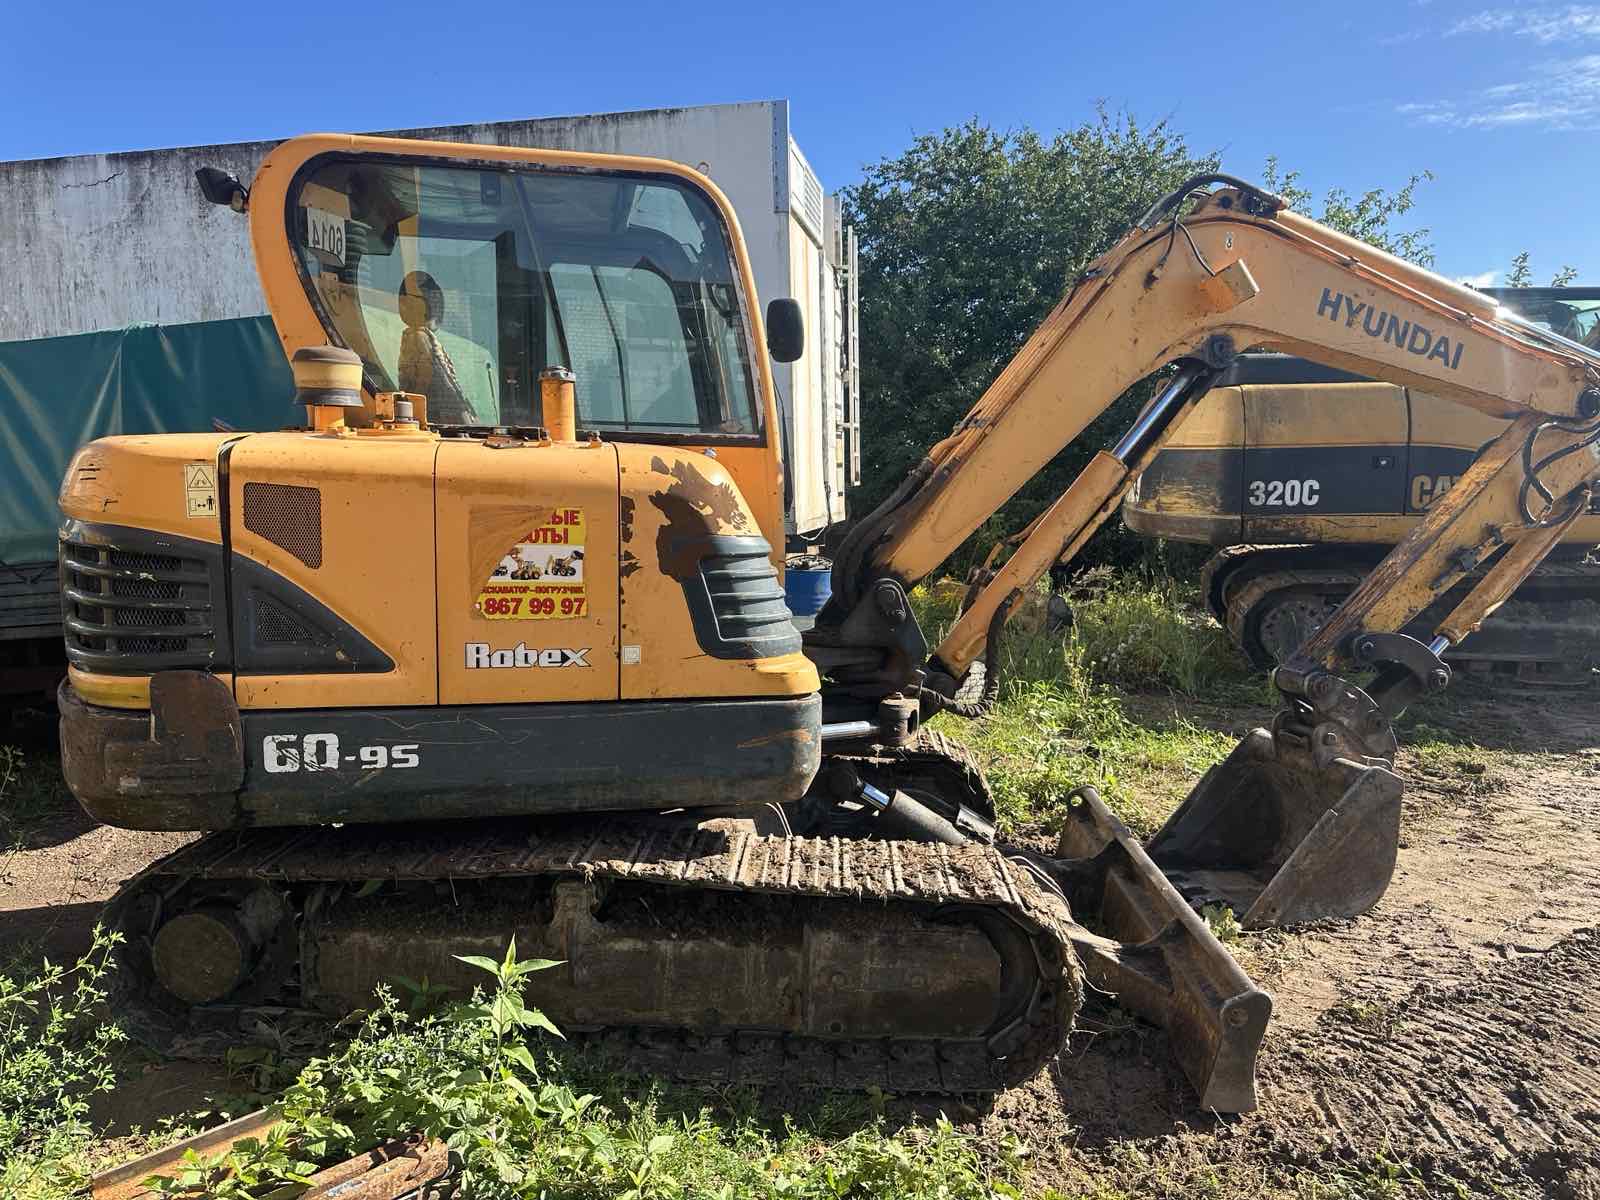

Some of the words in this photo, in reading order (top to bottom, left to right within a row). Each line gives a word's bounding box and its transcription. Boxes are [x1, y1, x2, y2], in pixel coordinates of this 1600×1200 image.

[1317, 287, 1464, 369] HYUNDAI
[1249, 480, 1320, 506] 320C
[1411, 474, 1461, 510] CA
[546, 509, 581, 526] ЫЕ
[518, 527, 569, 544] ОТЫ
[484, 597, 523, 615] 867
[528, 597, 555, 615] 99
[560, 597, 586, 615] 97
[465, 641, 592, 669] Robex
